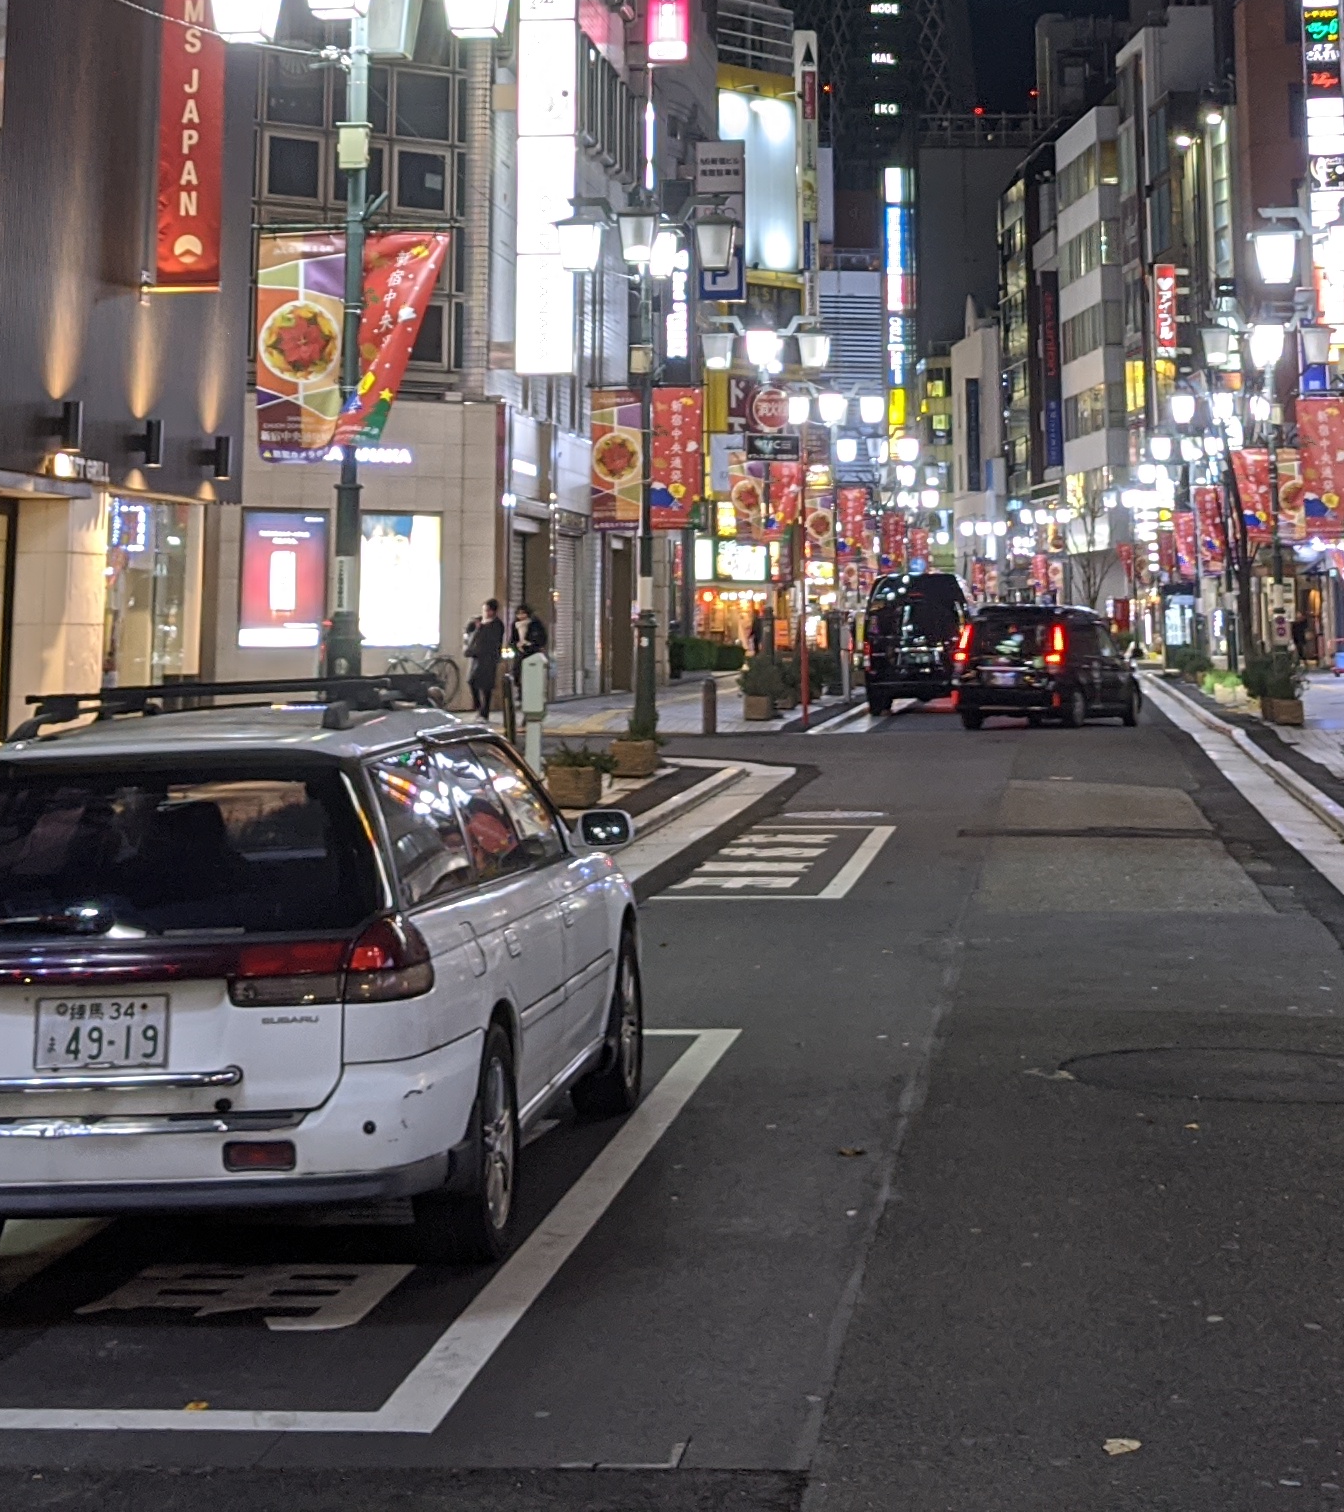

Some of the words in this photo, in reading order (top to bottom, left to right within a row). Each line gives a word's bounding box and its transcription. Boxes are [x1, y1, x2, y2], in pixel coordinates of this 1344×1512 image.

[179, 65, 202, 218] JAPAN
[68, 1002, 106, 1022] 練馬
[109, 1001, 137, 1020] 34
[260, 1015, 320, 1026] SUBARU
[64, 1024, 159, 1061] 49-19
